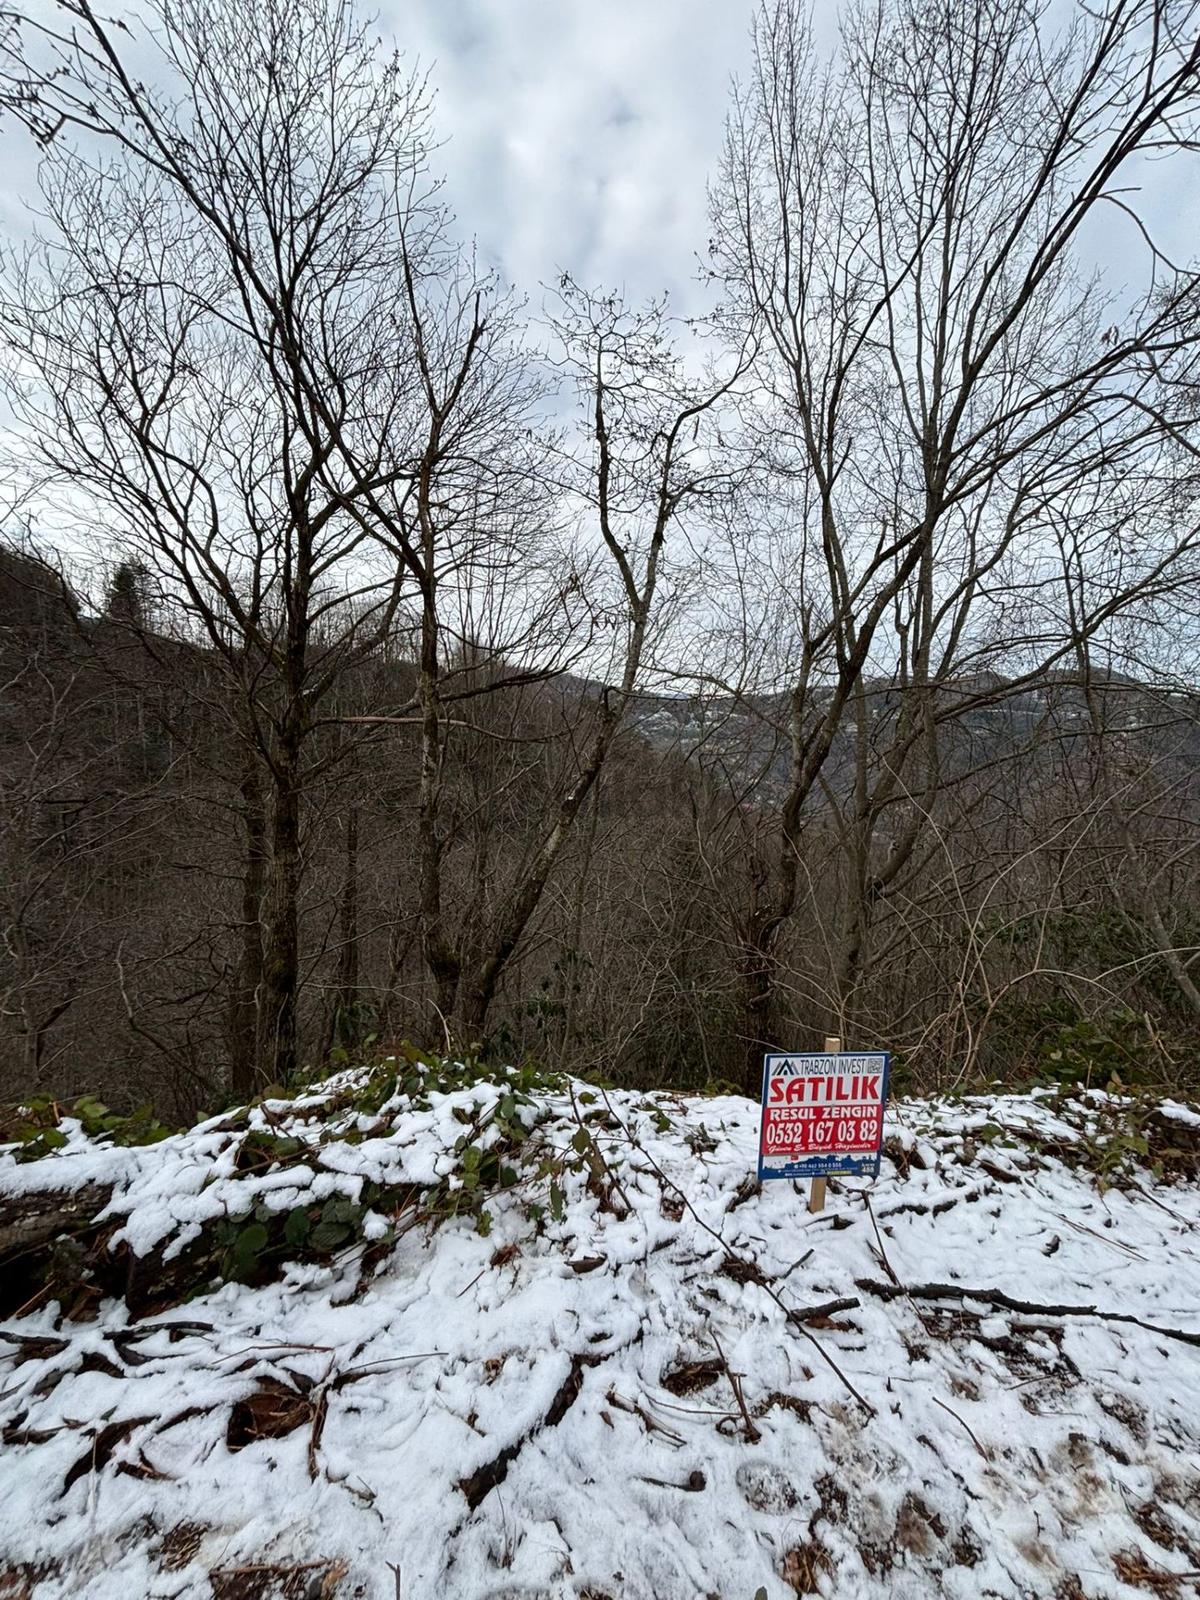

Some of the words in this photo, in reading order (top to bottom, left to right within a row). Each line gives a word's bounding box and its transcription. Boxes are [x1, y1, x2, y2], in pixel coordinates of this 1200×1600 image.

[800, 1060, 836, 1075] TRABZON
[839, 1058, 867, 1074] INVEST
[770, 1076, 880, 1105] SATILIK
[769, 1108, 817, 1121] RESUL
[766, 1122, 803, 1145] 0532
[807, 1121, 835, 1143] 167
[837, 1121, 856, 1142] 03
[859, 1119, 878, 1141] 82
